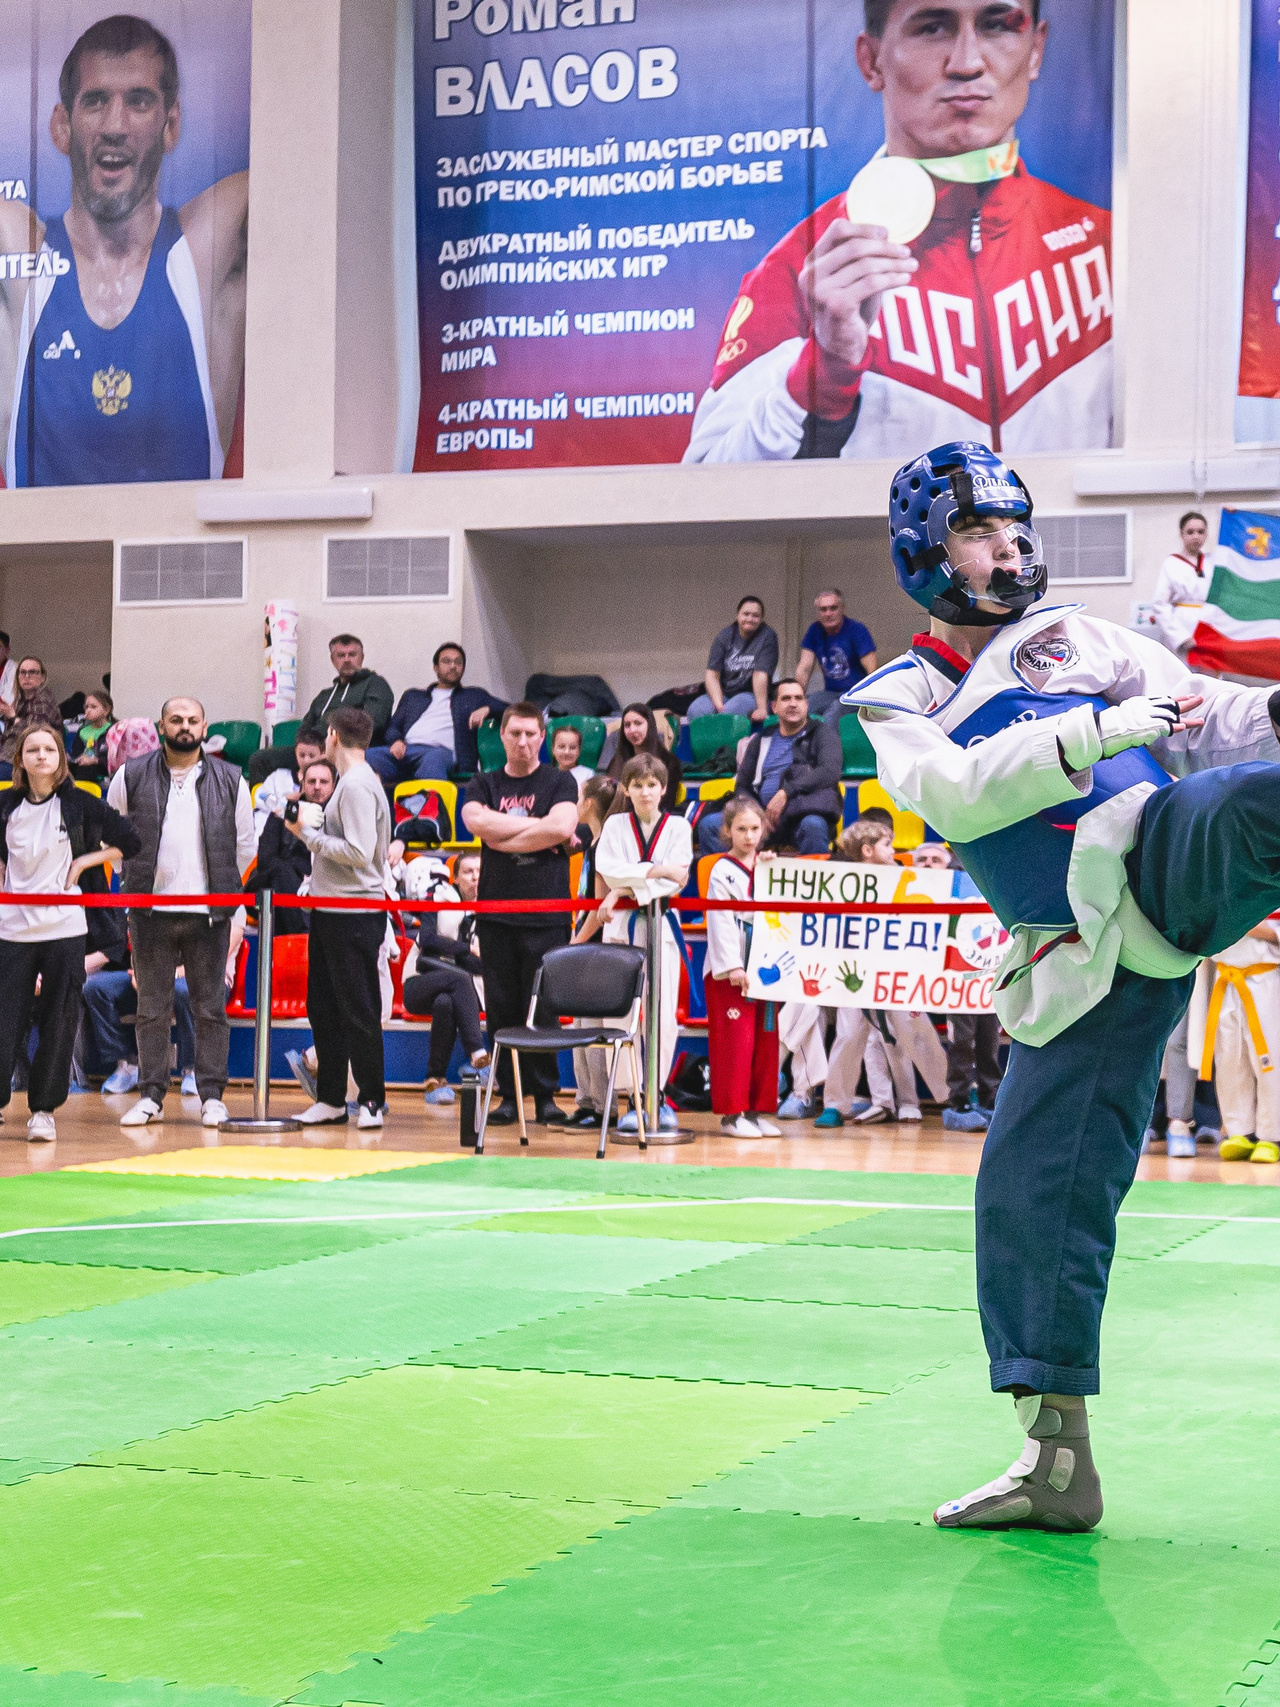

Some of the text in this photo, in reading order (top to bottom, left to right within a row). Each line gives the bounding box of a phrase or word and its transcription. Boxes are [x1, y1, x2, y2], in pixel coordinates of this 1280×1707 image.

[434, 0, 636, 40] Роман
[434, 46, 679, 117] ВЛАСОВ
[437, 127, 828, 178] ЗАСЛУЖЕННЫЙ МАСТЕР СПОРТА
[438, 160, 783, 208] ПО ГРЕКО-РИМСКОЙ БОРЬБЕ
[439, 218, 755, 265] ДВУКРАТНЫЙ ПОБЕДИТЕЛЬ
[440, 255, 668, 291] ОЛИМПИЙСКИХ ИГР
[441, 308, 695, 344] 3-КРАТНЫЙ ЧЕМПИОН
[441, 345, 497, 373] МИРА
[438, 392, 695, 425] 4-КРАТНЫЙ ЧЕМПИОН
[436, 428, 534, 454] ЕВРОПЫ
[768, 867, 879, 904] ЖУКОВ
